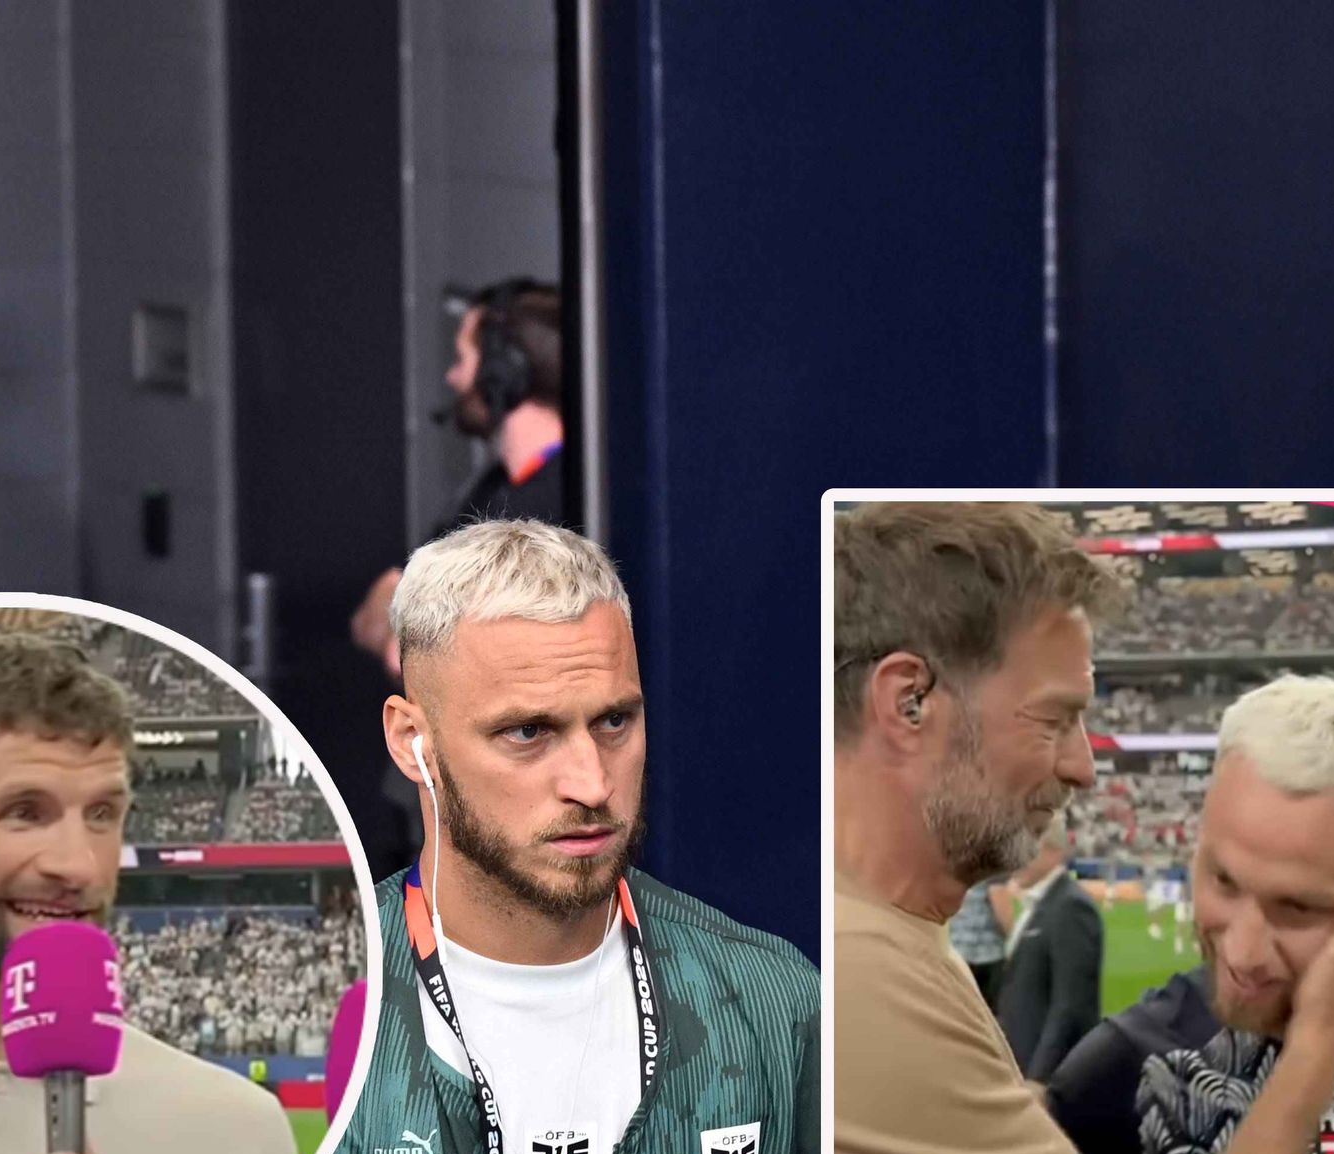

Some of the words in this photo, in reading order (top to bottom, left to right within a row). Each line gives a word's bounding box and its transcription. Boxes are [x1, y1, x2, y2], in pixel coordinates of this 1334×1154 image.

[428, 974, 451, 1018] FIFA
[481, 1087, 498, 1127] CUP
[643, 1017, 658, 1058] CUP
